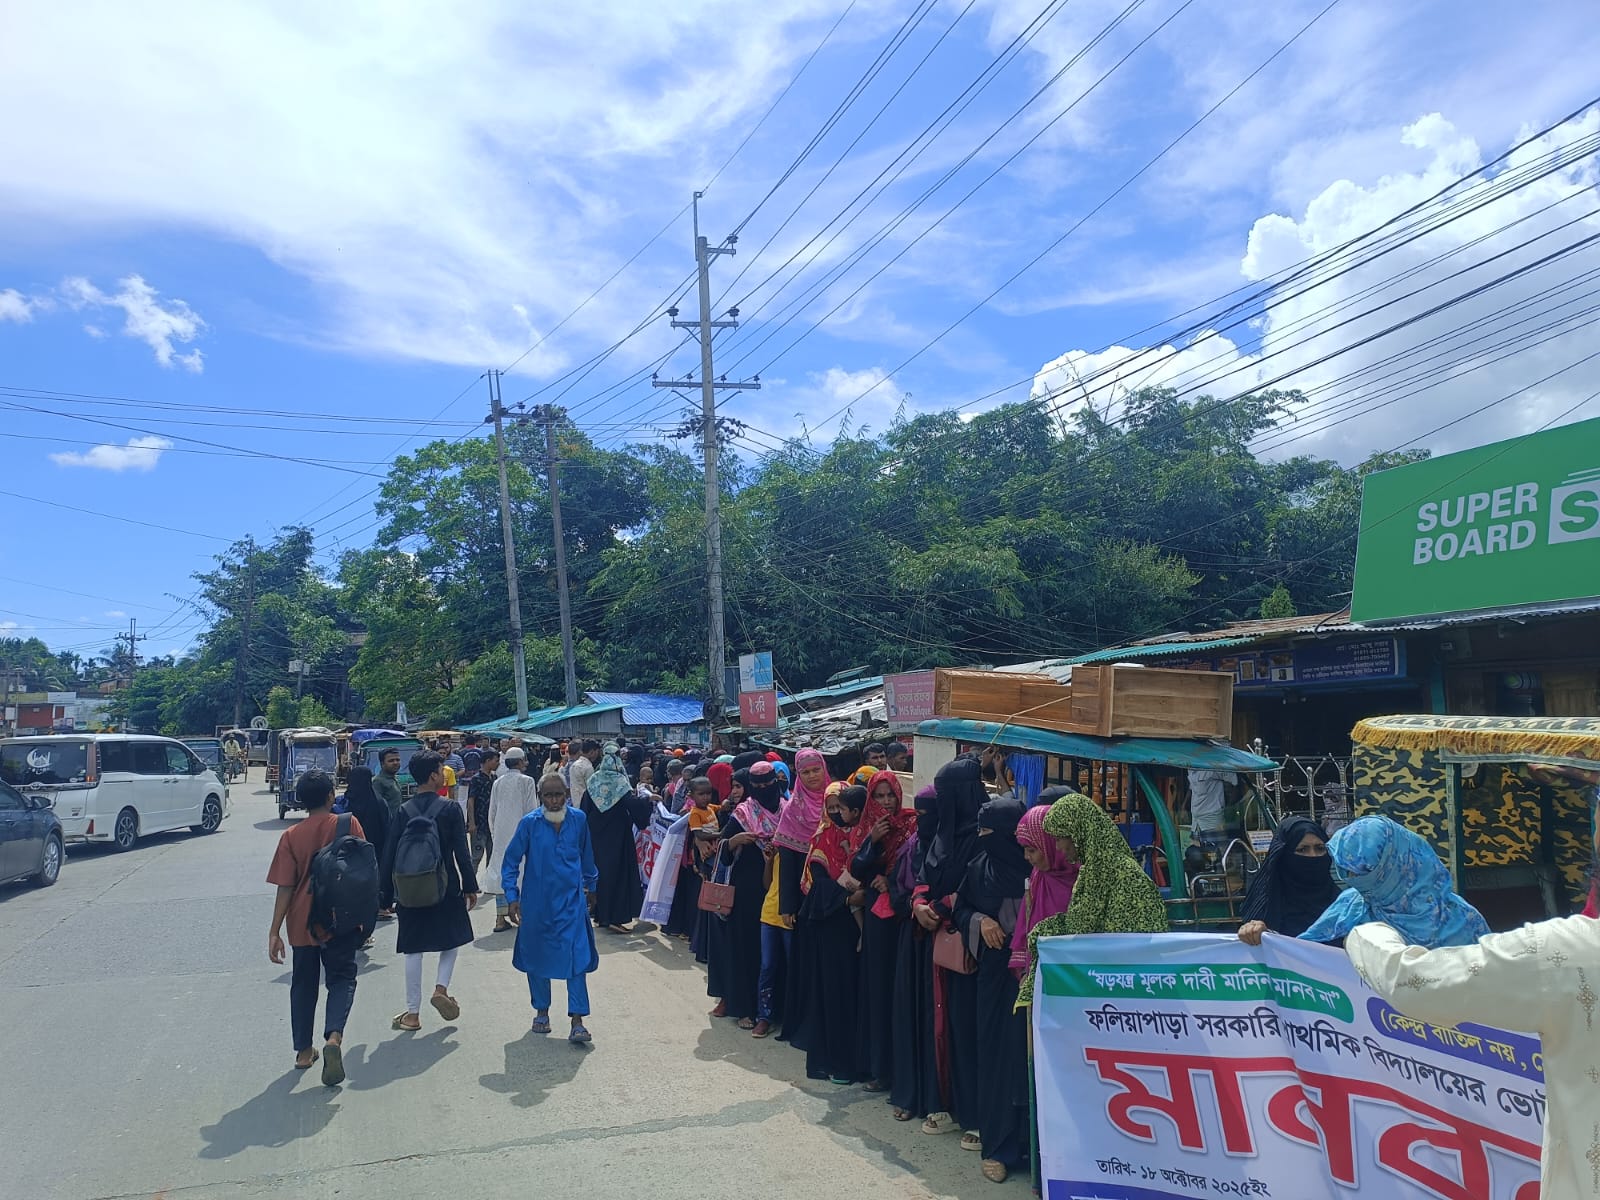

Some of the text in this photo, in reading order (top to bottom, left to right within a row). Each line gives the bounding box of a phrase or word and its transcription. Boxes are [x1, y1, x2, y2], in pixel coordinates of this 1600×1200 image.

[1416, 482, 1539, 532] SUPER
[1413, 520, 1536, 565] BOARD
[1139, 973, 1177, 995] মূলক
[1181, 966, 1216, 990] দাবী
[1085, 1004, 1188, 1039] ফলিয়াপাড়া
[1192, 1006, 1281, 1039] সরকারি
[1363, 1036, 1487, 1106] বিদ্যালয়ের
[1141, 1165, 1157, 1180] ১৮
[1159, 1167, 1208, 1191] অক্টোবর
